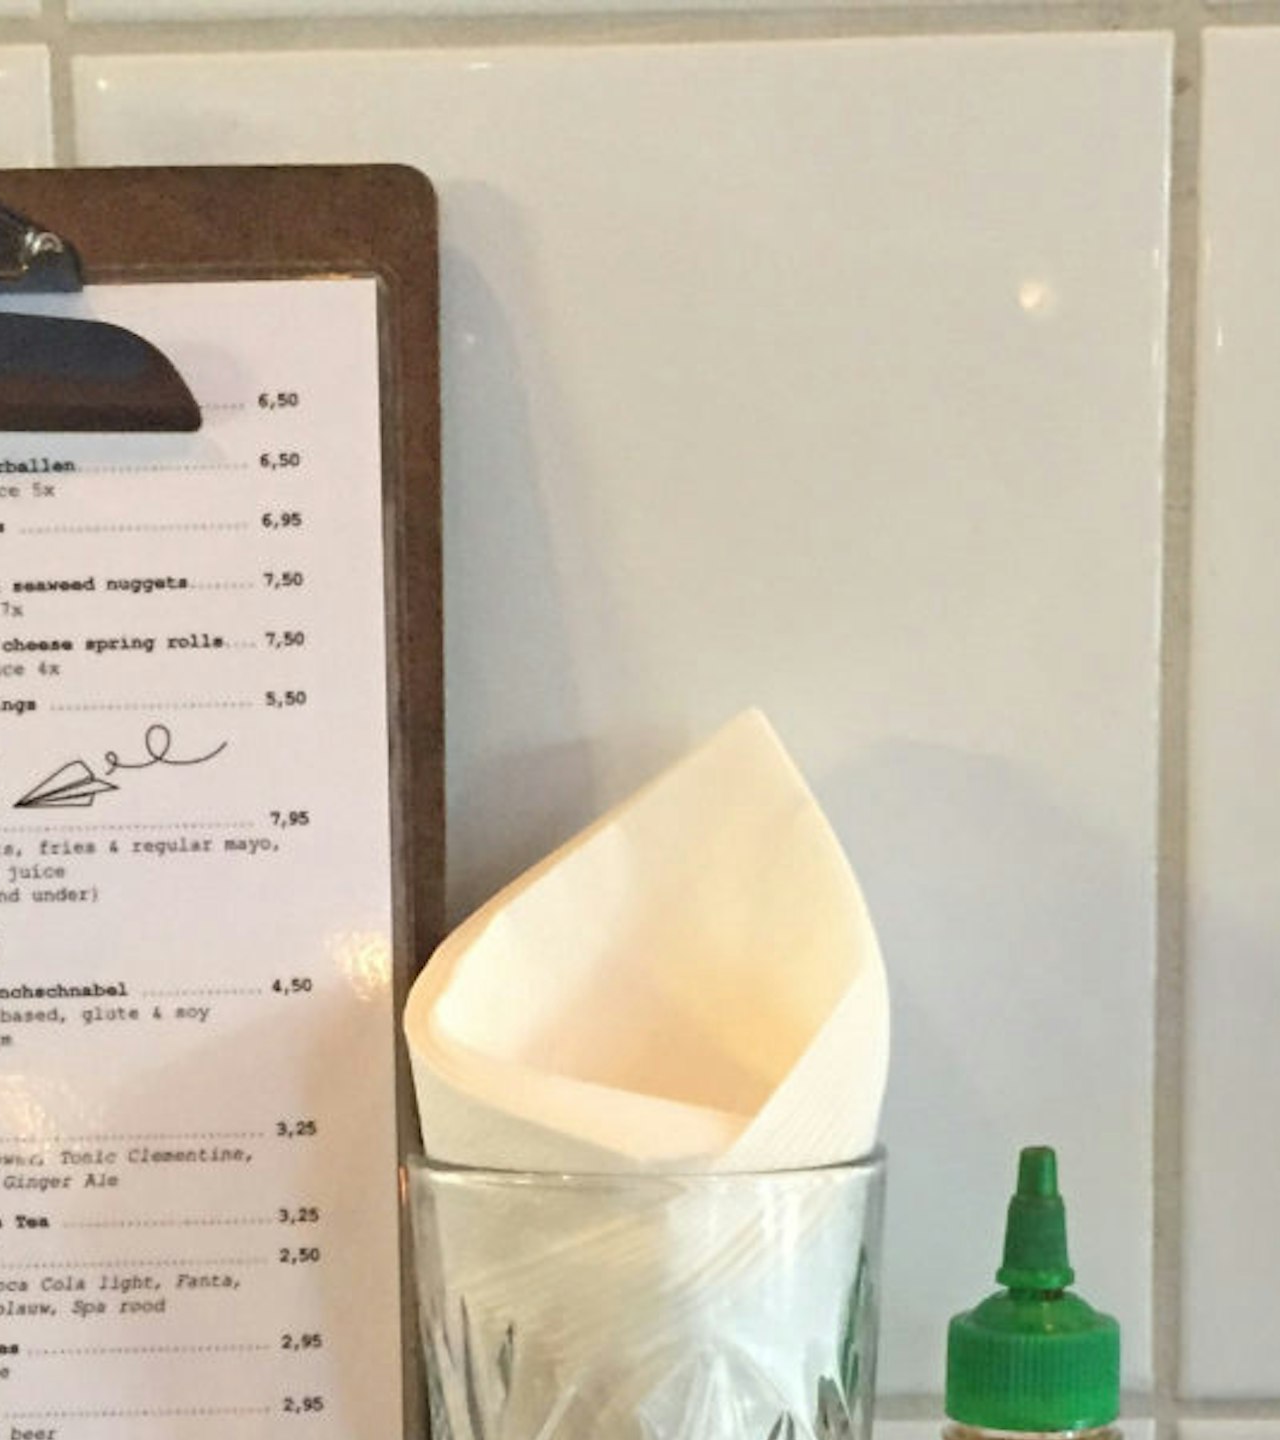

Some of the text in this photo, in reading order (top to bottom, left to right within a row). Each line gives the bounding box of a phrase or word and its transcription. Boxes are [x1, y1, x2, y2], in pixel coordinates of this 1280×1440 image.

[258, 392, 299, 410] 6,50
[259, 452, 301, 470] 6,50
[261, 511, 302, 529] 6,95
[13, 577, 96, 593] seaweed
[106, 577, 189, 593] nuggets
[263, 571, 304, 589] 7,50
[2, 638, 73, 652] cheese
[85, 638, 156, 654] spring
[167, 633, 224, 649] rolls
[265, 630, 305, 649] 7,50
[265, 690, 307, 708] 5,50
[270, 810, 310, 828] 7,95
[272, 977, 312, 995] 4,50
[276, 1120, 317, 1138] 3,25
[15, 1214, 50, 1229] Tea
[279, 1207, 320, 1224] 3,25
[279, 1247, 321, 1264] 2,50
[281, 1333, 322, 1351] 2,95
[283, 1396, 324, 1414] 2,95
